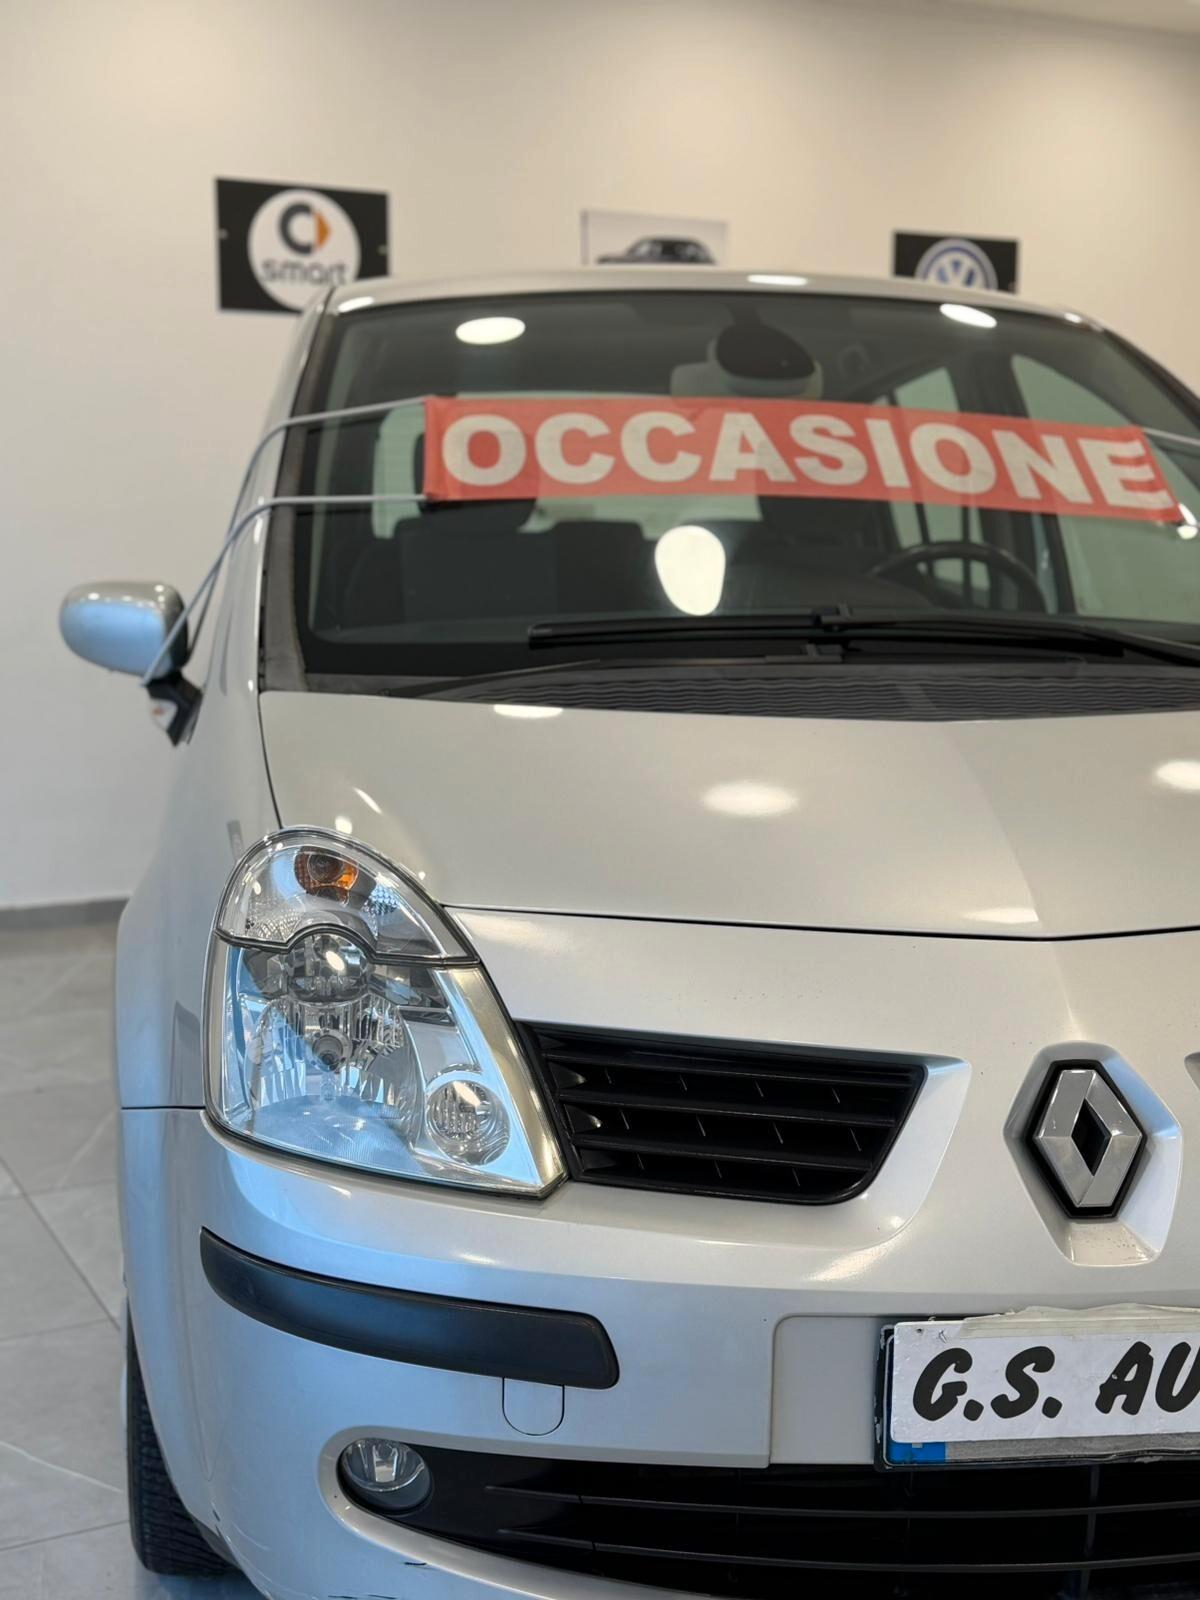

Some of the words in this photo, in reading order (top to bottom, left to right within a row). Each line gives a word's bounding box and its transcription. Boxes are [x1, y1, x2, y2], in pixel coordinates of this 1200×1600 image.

[261, 257, 347, 286] smart
[441, 411, 1175, 510] OCCASIONE
[912, 1345, 1063, 1422] G.S.
